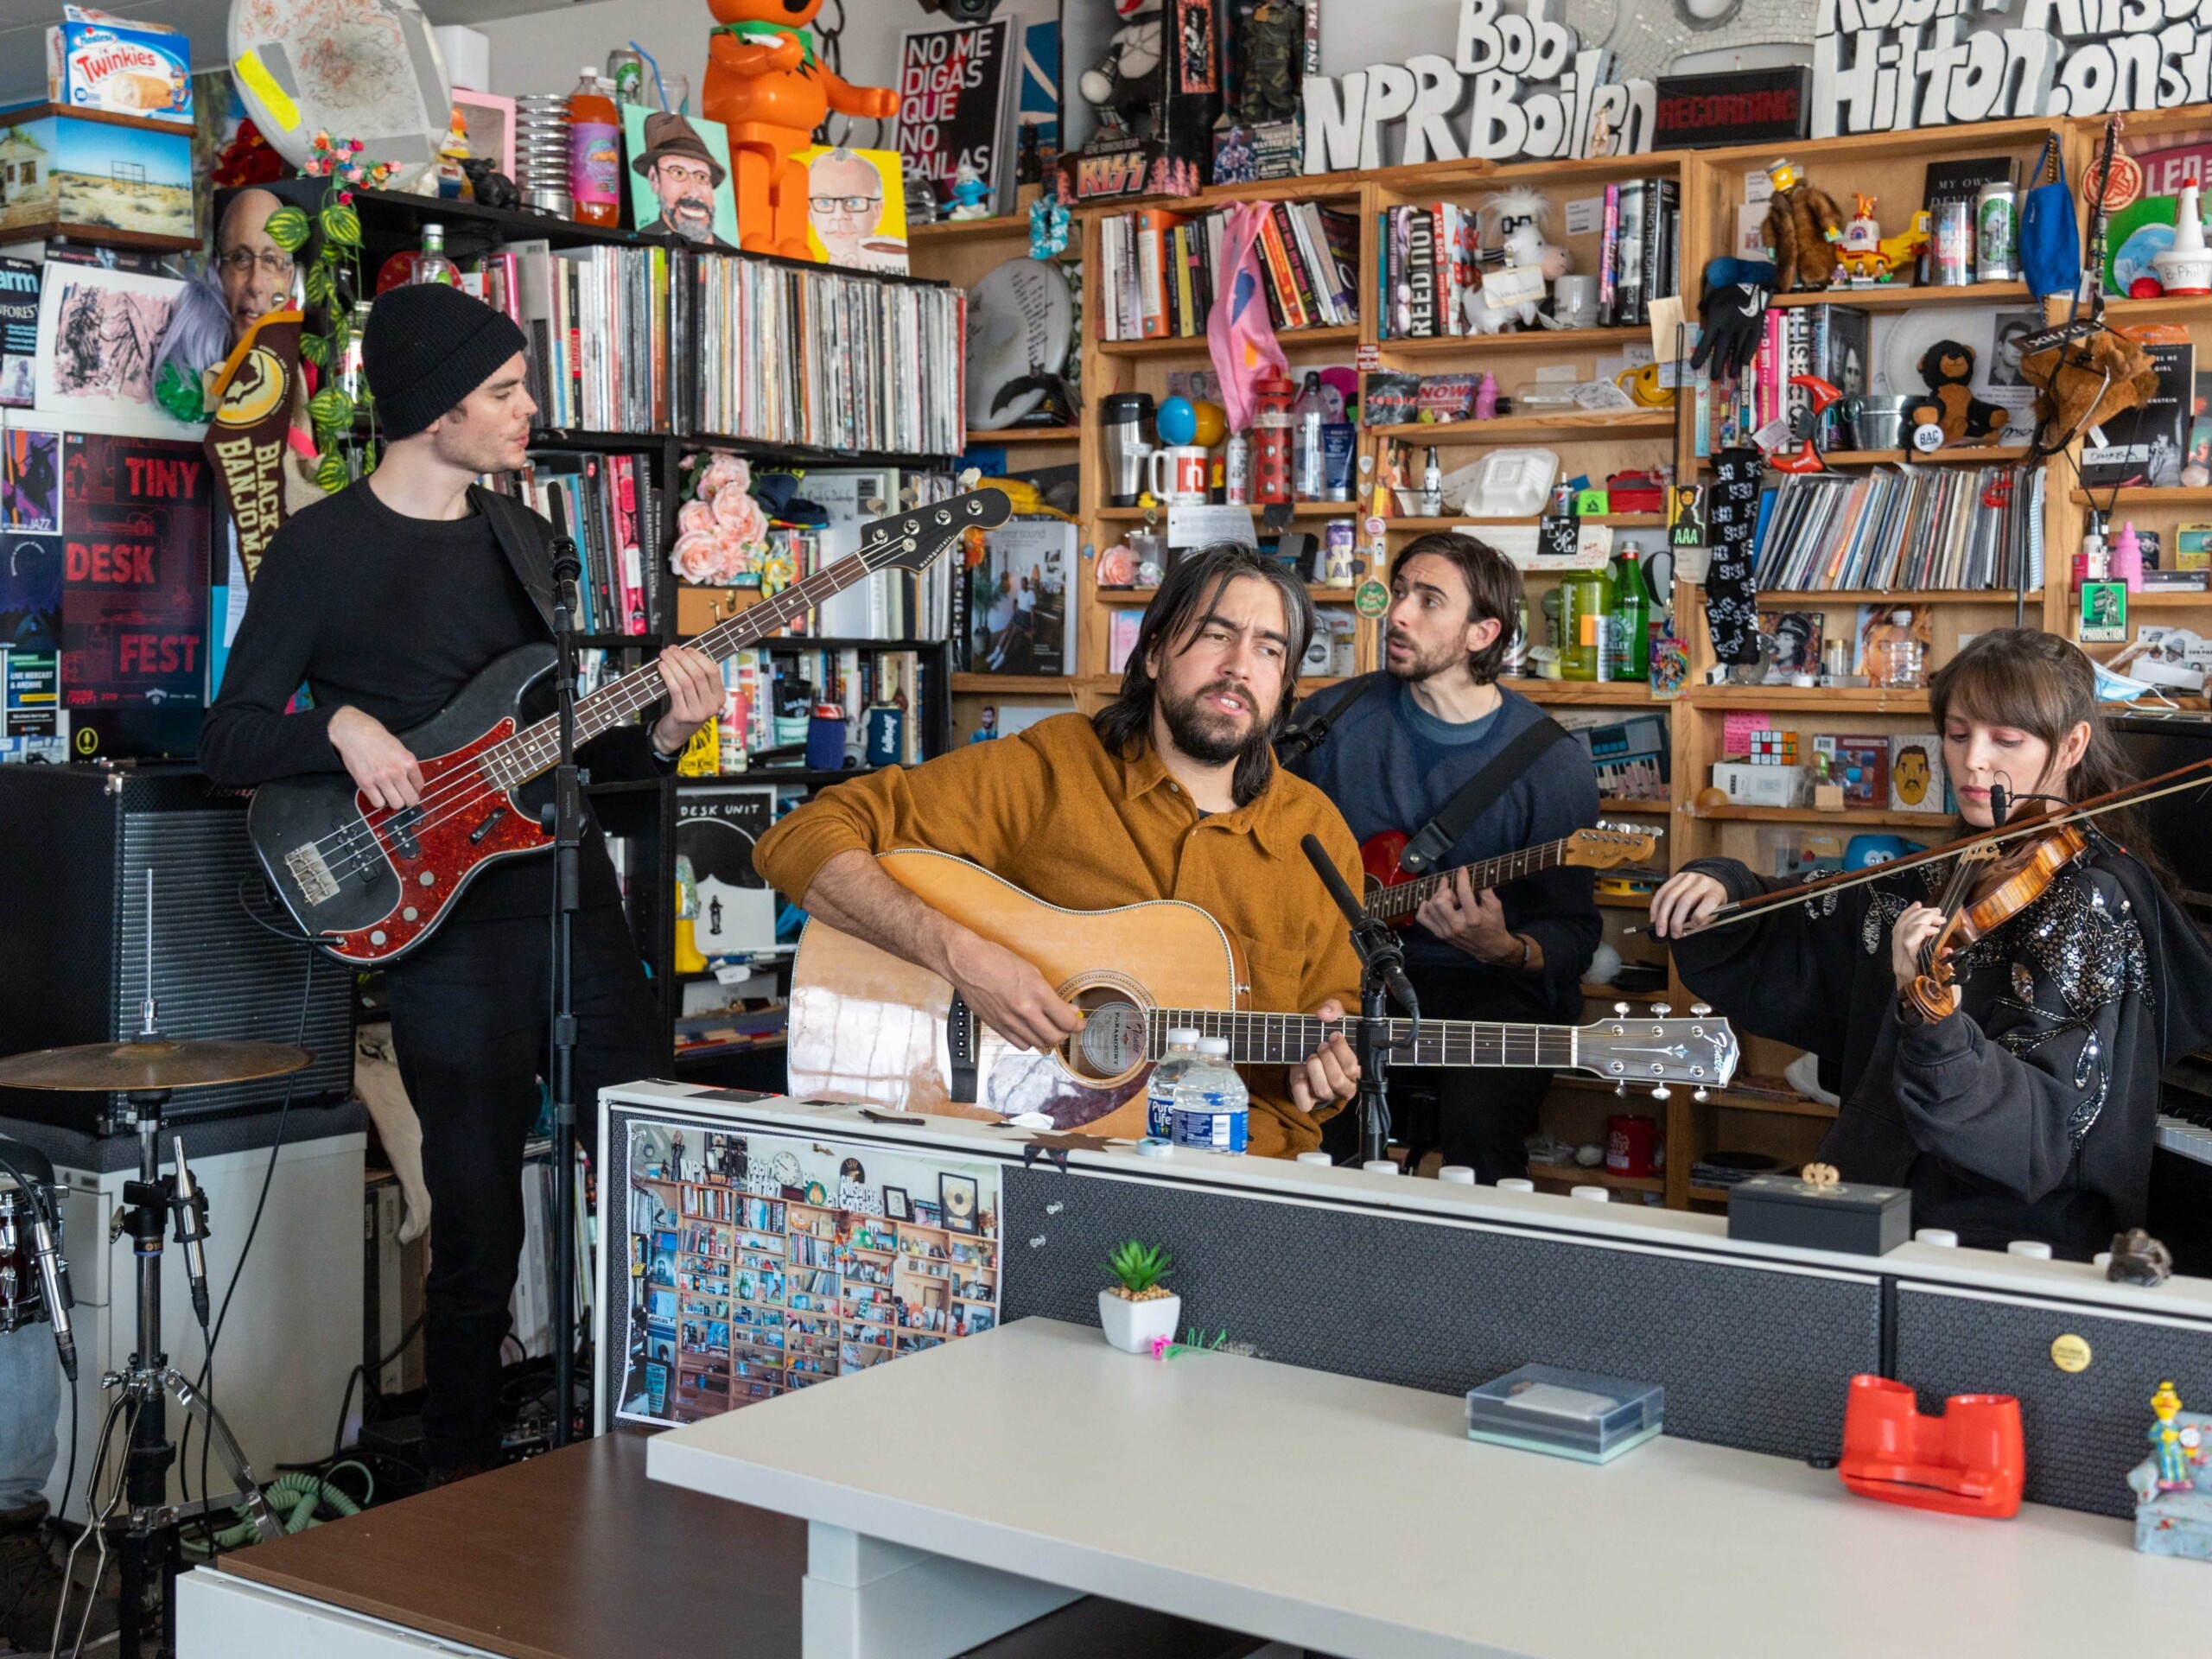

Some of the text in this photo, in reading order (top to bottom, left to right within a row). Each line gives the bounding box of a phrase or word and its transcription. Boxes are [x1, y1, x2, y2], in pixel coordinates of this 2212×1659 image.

[907, 27, 995, 67] NO ME
[1456, 0, 1568, 80] Bob
[76, 46, 156, 84] Twinkies
[904, 60, 984, 99] DIGAS
[1811, 16, 2044, 138] Hilton
[900, 91, 957, 124] QUE
[1302, 54, 1470, 175] NPR
[1469, 50, 1656, 161] Boilen
[1657, 88, 1798, 130] RECORDING
[899, 124, 939, 155] NO
[899, 143, 991, 181] BAILAS
[1077, 150, 1148, 198] KISS
[1938, 180, 1956, 189] MY
[1433, 213, 1445, 263] ASK BOB
[1643, 191, 1656, 280] SEEING THE LIGHT
[874, 264, 907, 276] WISH
[1410, 272, 1433, 337] REED
[1419, 385, 1468, 398] NOW
[1919, 430, 1940, 446] BAC
[124, 456, 201, 500] TINY
[255, 439, 281, 533] BLACK
[643, 472, 652, 512] LEONARD
[29, 518, 52, 531] JAZZ
[214, 435, 263, 583] BANJO MA
[645, 513, 656, 560] BERNSTEIN
[1674, 527, 1699, 545] AAA
[66, 543, 156, 584] DESK
[649, 561, 656, 572] AT
[2083, 628, 2125, 640] PRODUCTION
[119, 634, 200, 674] FEST
[16, 681, 43, 690] ARCHIVE
[24, 671, 54, 681] WEBCAST
[679, 804, 760, 817] DESK UNIT
[1703, 1032, 1727, 1073] Fender
[1152, 1100, 1174, 1114] Pure
[1154, 1110, 1172, 1128] Life
[747, 1154, 776, 1179] Robin
[747, 1174, 782, 1198] Hilton
